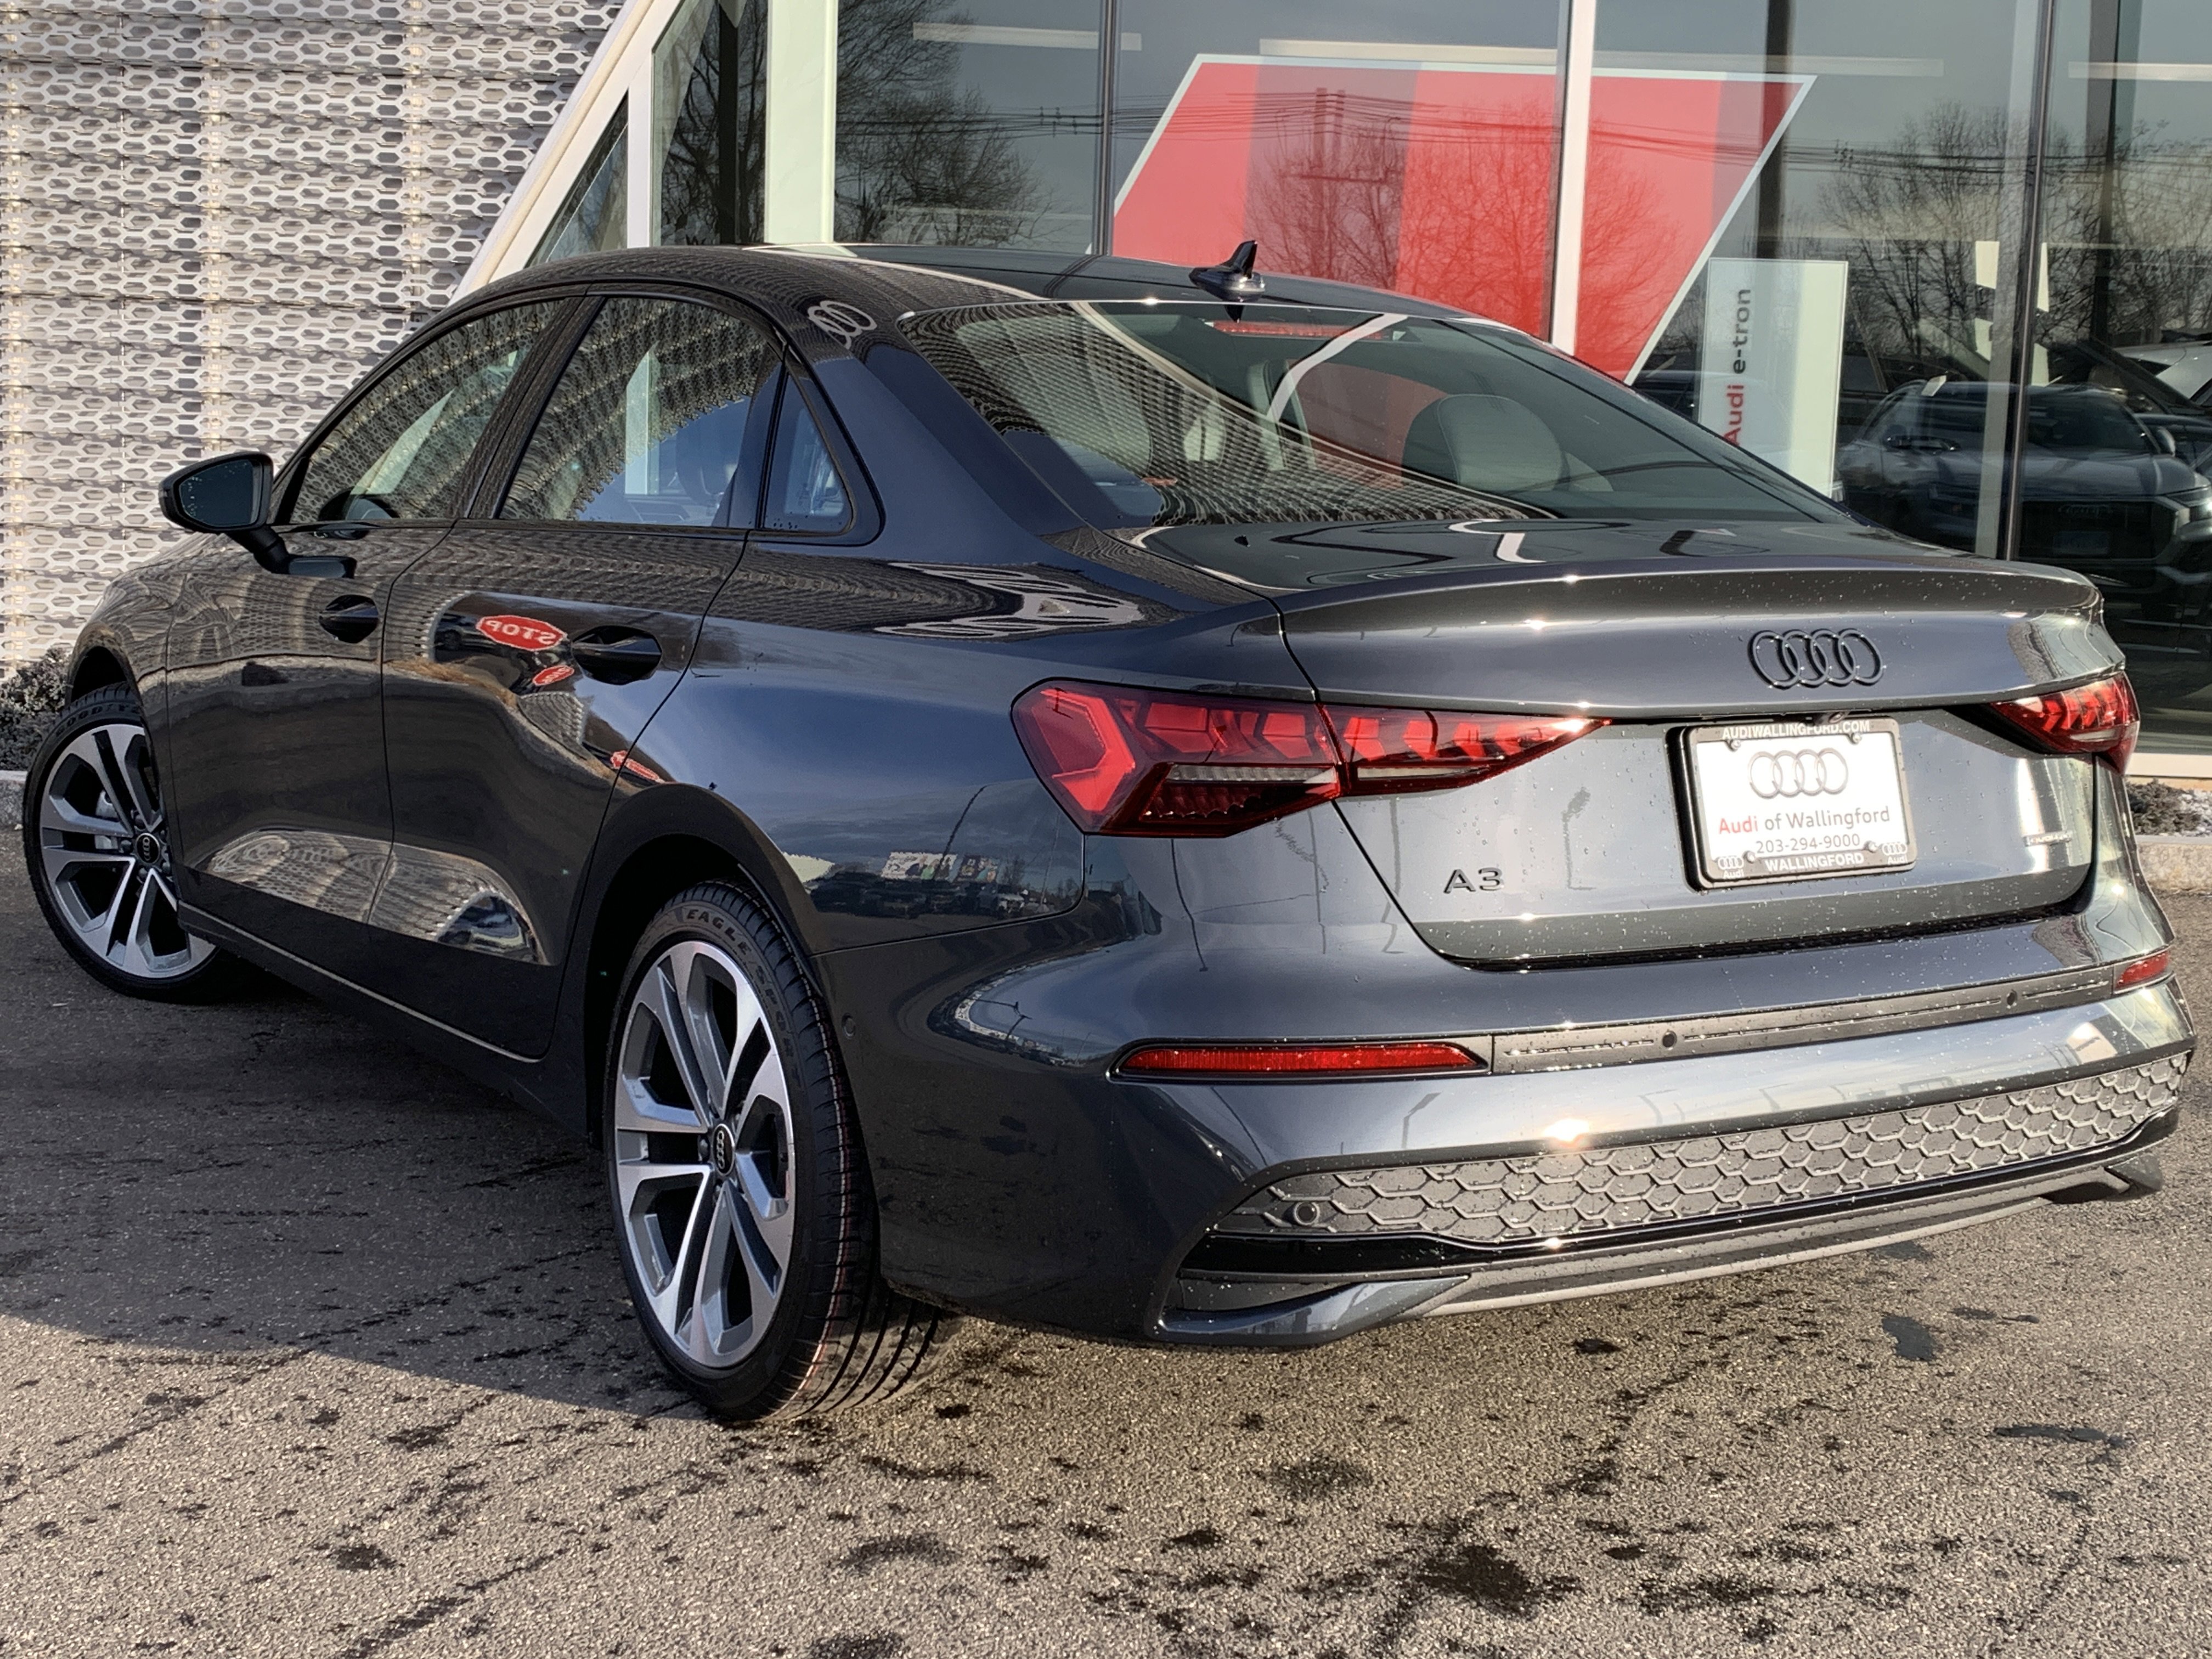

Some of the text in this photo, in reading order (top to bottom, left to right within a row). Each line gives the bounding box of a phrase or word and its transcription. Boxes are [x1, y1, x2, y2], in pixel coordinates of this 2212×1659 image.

[1723, 290, 1751, 447] Audi e-tron
[1722, 720, 1870, 740] AUDIWALLINGFORD.COM
[1719, 805, 1890, 834] Audi of Wallingford
[1756, 833, 1860, 855] 203-294-9000
[1765, 852, 1865, 872] WALLINGFORD
[1887, 855, 1908, 865] Audi
[1443, 867, 1505, 894] A3
[1723, 870, 1745, 879] Audi
[686, 909, 752, 955] EAGLE
